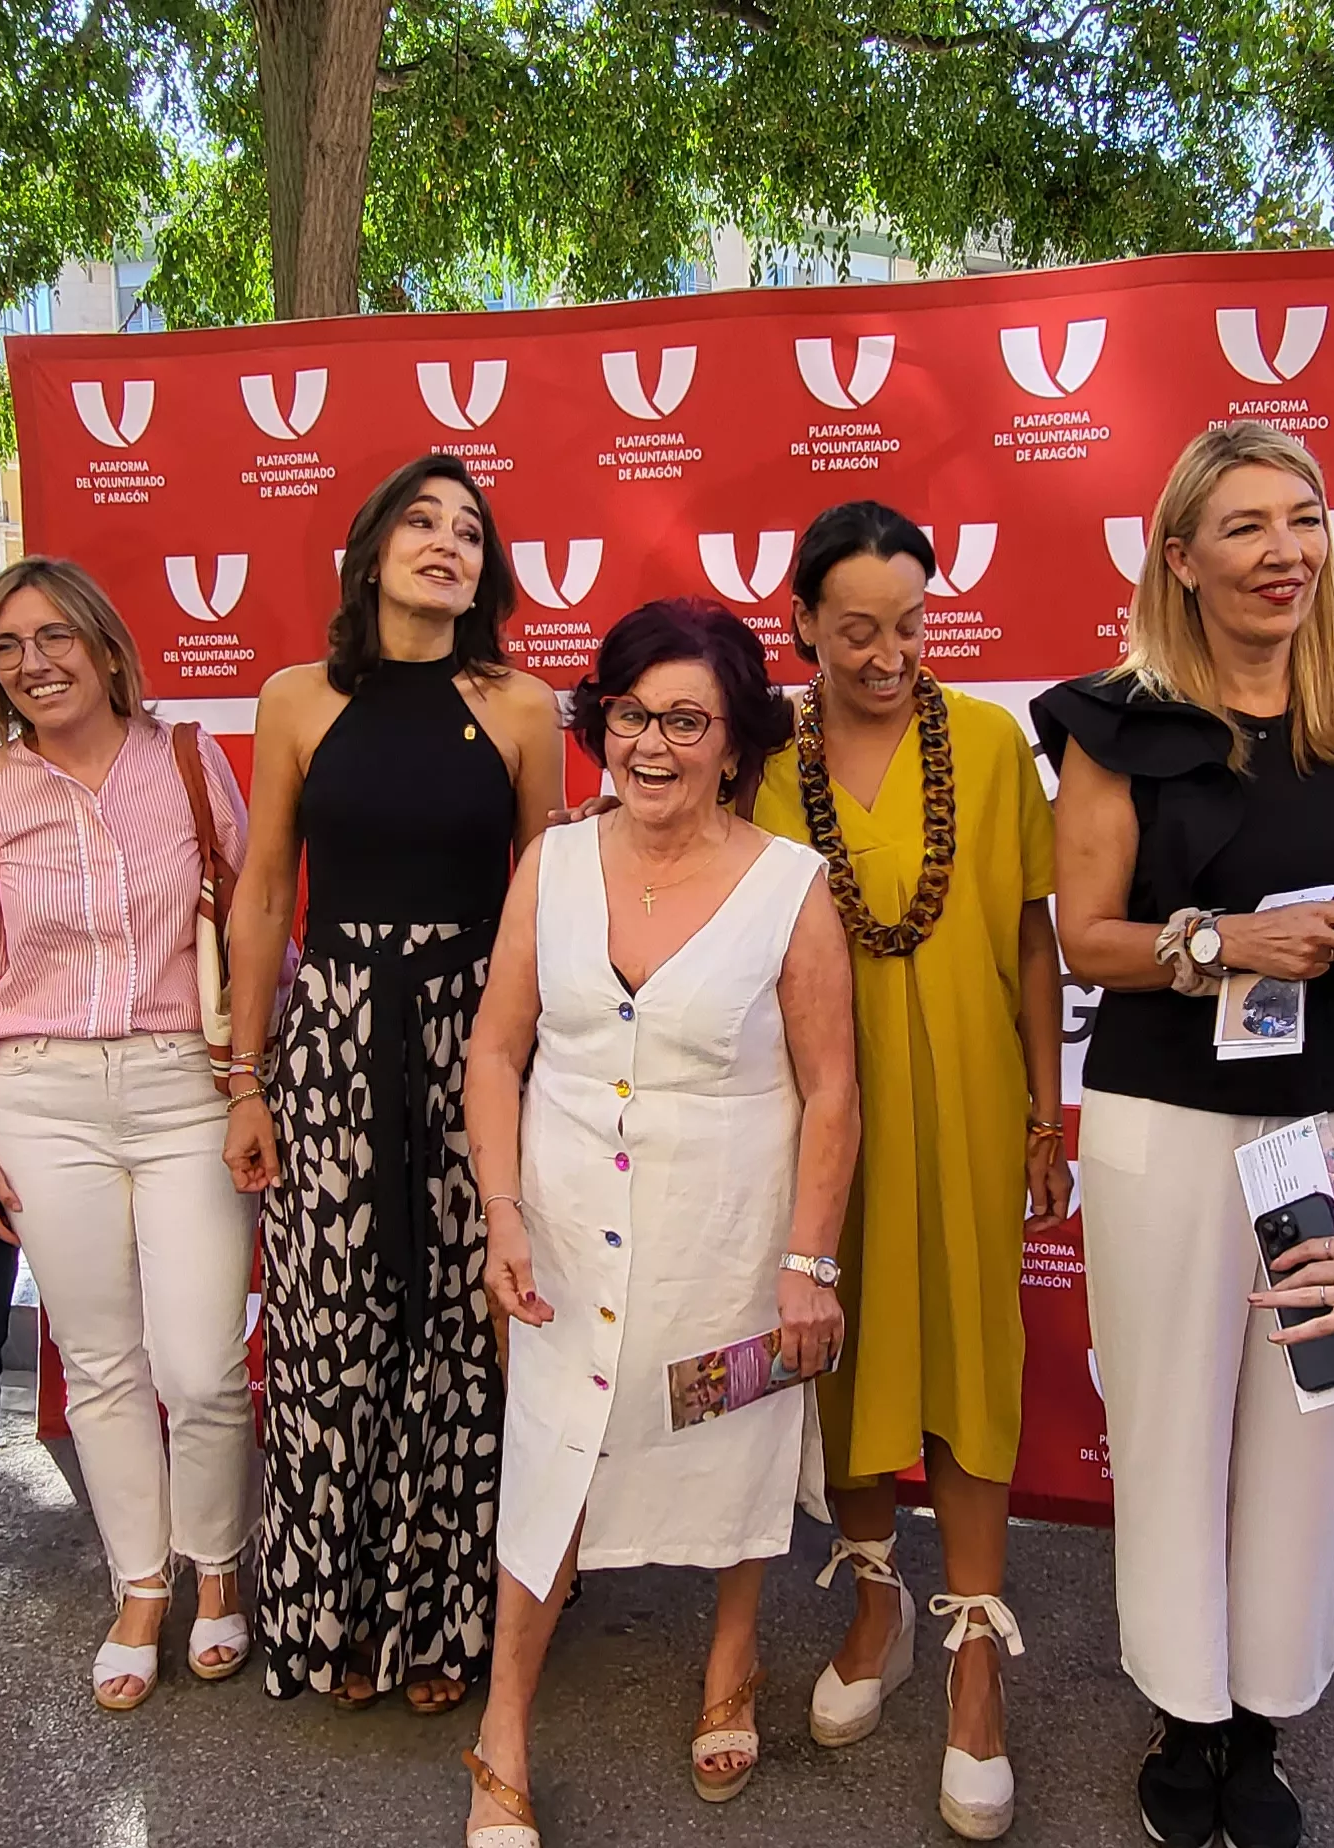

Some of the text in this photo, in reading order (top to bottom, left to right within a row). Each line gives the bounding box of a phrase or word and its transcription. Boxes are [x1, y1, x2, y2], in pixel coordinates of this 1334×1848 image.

[1229, 399, 1309, 414] PLATAFORMA
[1014, 411, 1090, 428] PLATAFORMA
[808, 423, 881, 438] PLATAFORMA
[994, 427, 1110, 446] DEL VOLUNTARIADO
[615, 433, 684, 448] PLATAFORMA
[791, 438, 900, 456] DEL VOLUNTARIADO
[256, 452, 319, 467] PLATAFORMA
[598, 448, 702, 466] DEL VOLUNTARIADO
[1016, 443, 1087, 462] DE ARAGÓN
[89, 461, 149, 473] PLATAFORMA
[811, 454, 878, 471] DE ARAGÓN
[241, 467, 336, 484] DEL VOLUNTARIADO
[618, 463, 682, 480] DE ARAGÓN
[76, 476, 165, 489] DEL VOLUNTARIADO
[260, 482, 318, 498] DE ARAGÓN
[94, 490, 149, 504] DE ARAGÓN
[923, 611, 983, 624] ATAFORMA
[524, 623, 591, 636] PLATAFORMA
[1097, 624, 1118, 637] DEL
[178, 634, 239, 647] PLATAFORMA
[508, 640, 526, 652] DEL
[163, 648, 255, 663] DEL VOLUNTARIADO
[928, 641, 980, 658] ARAGÓN
[527, 652, 589, 668] DE ARAGÓN
[181, 662, 237, 677] DE ARAGÓN
[1022, 1242, 1075, 1256] TAFORMA
[1020, 1274, 1072, 1288] ARAGÓN
[1080, 1448, 1099, 1462] DEL
